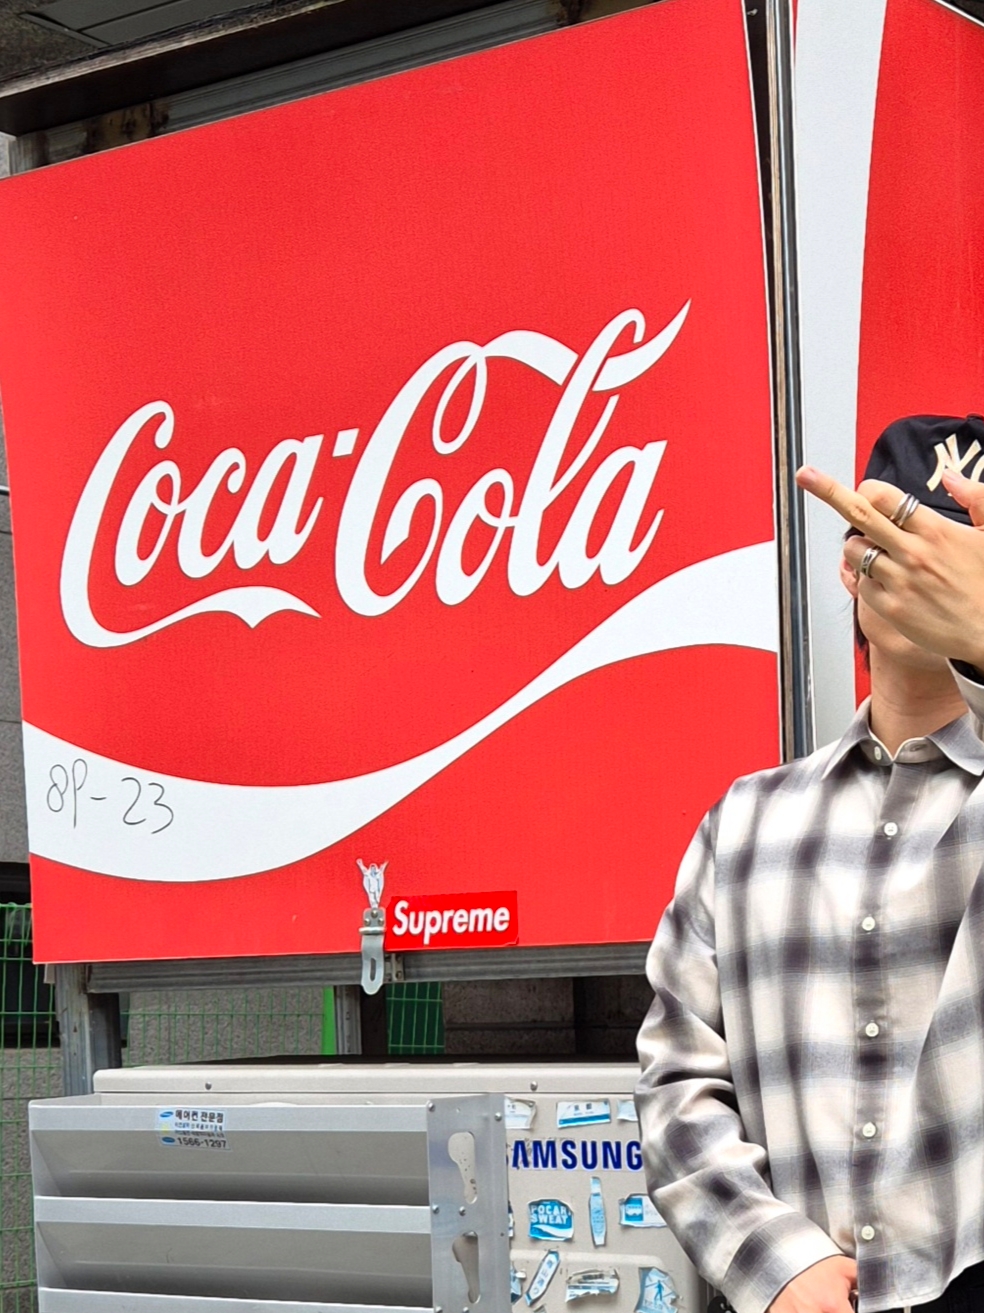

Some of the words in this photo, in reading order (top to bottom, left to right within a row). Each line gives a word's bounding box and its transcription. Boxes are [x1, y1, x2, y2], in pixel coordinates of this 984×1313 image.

[60, 298, 692, 648] Coca-Cola
[392, 899, 511, 946] Supreme
[506, 1140, 643, 1170] AMSUNG
